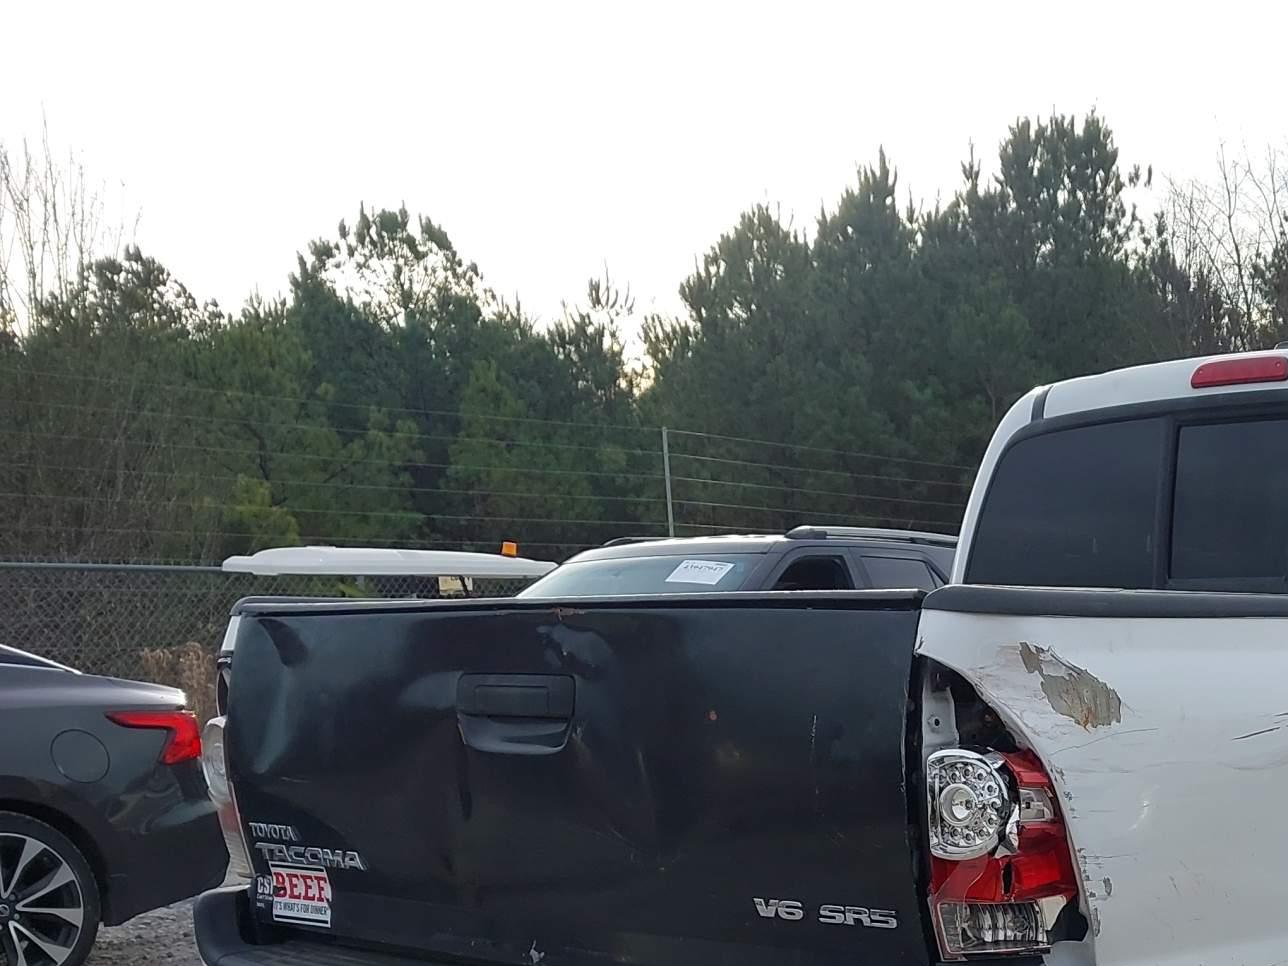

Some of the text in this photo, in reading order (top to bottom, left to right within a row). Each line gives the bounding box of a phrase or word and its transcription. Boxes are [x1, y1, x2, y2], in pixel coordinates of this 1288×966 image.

[249, 822, 298, 841] TOYOTA
[254, 842, 366, 871] TACOMA
[273, 872, 328, 902] BEEF
[300, 904, 310, 914] FOR
[753, 897, 804, 921] V6
[818, 904, 897, 928] SR5
